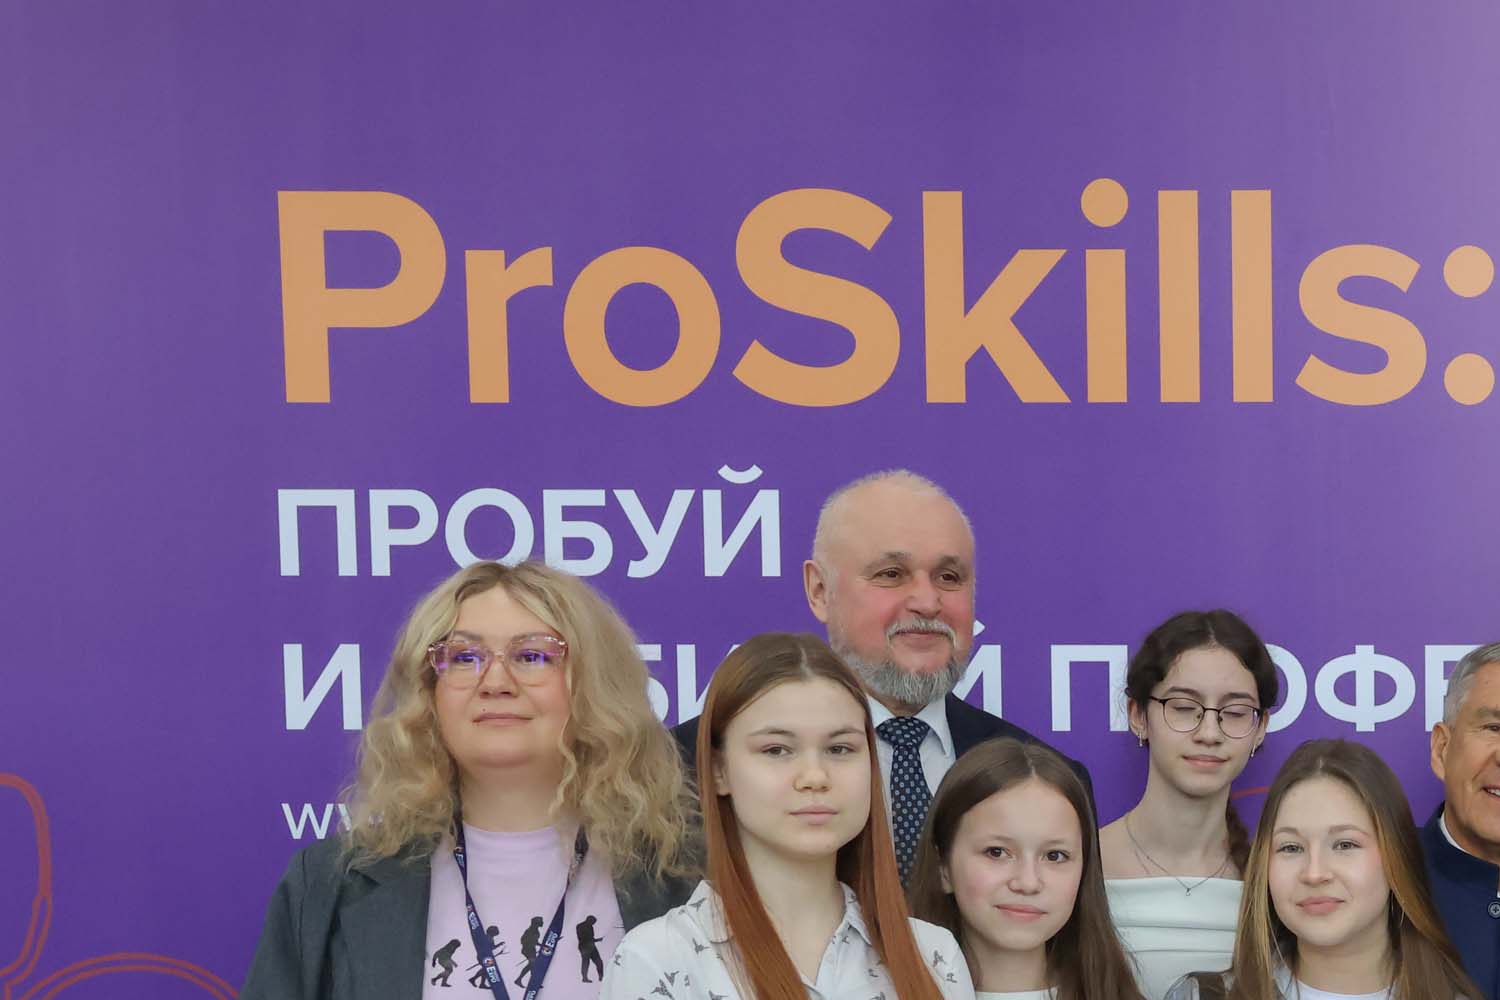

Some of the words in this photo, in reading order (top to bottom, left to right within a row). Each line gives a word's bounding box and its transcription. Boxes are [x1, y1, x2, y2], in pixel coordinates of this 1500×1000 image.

[277, 178, 1494, 406] ProSkills:
[278, 464, 781, 577] ПРОБУЙ
[283, 643, 362, 730] И
